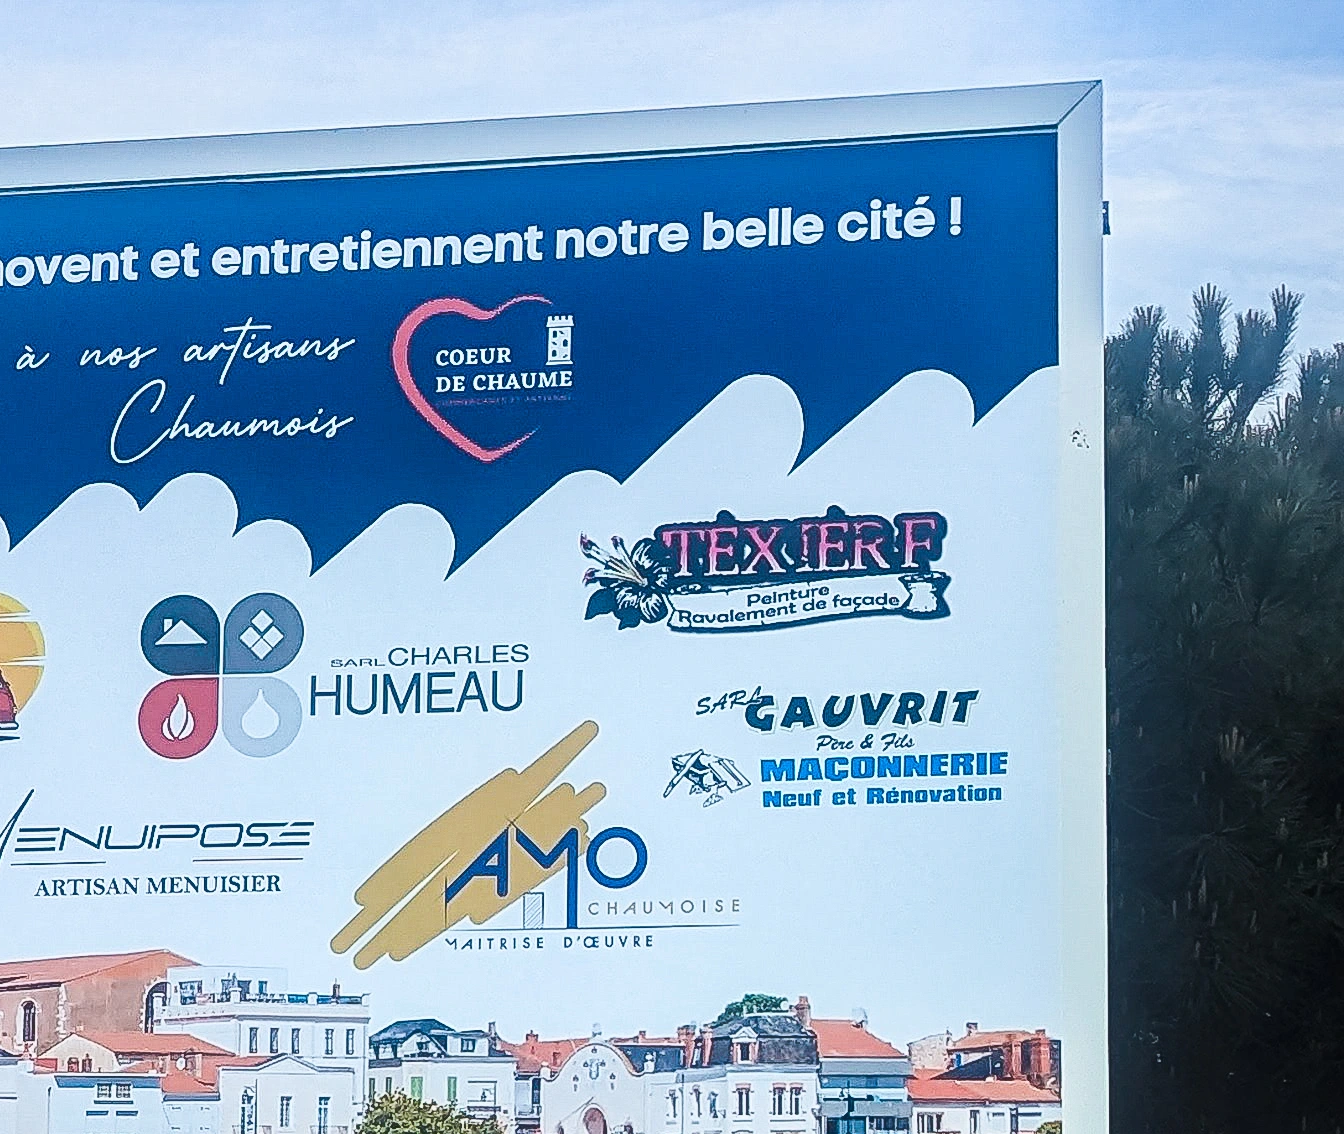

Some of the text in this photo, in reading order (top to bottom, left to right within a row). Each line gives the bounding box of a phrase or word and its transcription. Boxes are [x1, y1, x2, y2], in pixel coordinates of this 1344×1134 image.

[150, 243, 200, 279] et
[211, 224, 544, 276] entretiennent
[555, 217, 689, 261] notre
[702, 206, 824, 252] belle
[837, 196, 936, 242] cité
[948, 196, 963, 236] !
[16, 345, 50, 370] à
[79, 346, 158, 369] nos
[183, 316, 356, 386] artisans
[435, 347, 512, 367] COEUR
[435, 370, 573, 393] DE CHAUME
[110, 378, 355, 464] Chaumois
[901, 516, 937, 568] F
[678, 592, 901, 626] Ravalement de façade
[746, 585, 830, 608] Peinture
[330, 643, 530, 668] SARL CHARLES
[309, 669, 524, 716] HUMEAU
[695, 686, 980, 732] SARL GAUVRIT
[859, 733, 874, 750] &
[880, 732, 915, 752] Fils
[760, 751, 1009, 783] MAÇONNERIE
[762, 784, 1002, 808] Neuf et Rénovation
[33, 874, 282, 897] ARTISAN MENUISIER
[445, 826, 649, 930] AMO
[587, 899, 741, 917] CHAUMOISE
[444, 936, 545, 951] MAITRISE
